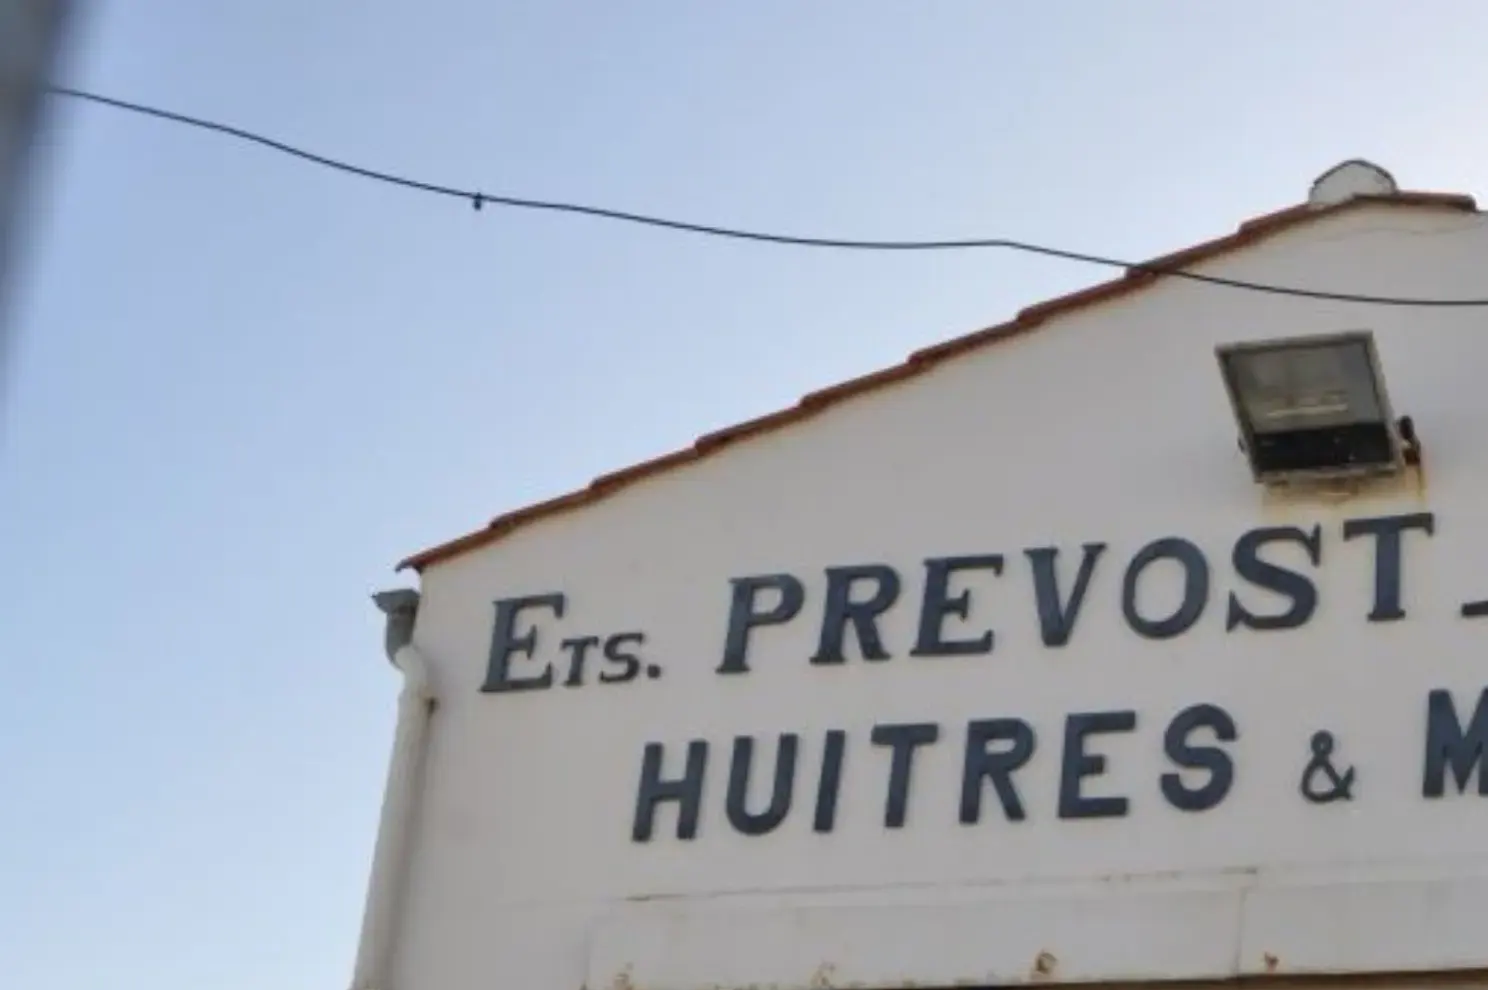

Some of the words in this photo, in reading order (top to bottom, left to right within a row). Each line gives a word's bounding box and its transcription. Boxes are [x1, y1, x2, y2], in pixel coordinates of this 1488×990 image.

[715, 512, 1435, 675] PREVOST
[631, 703, 1238, 843] HUITRES
[1300, 730, 1355, 805] &
